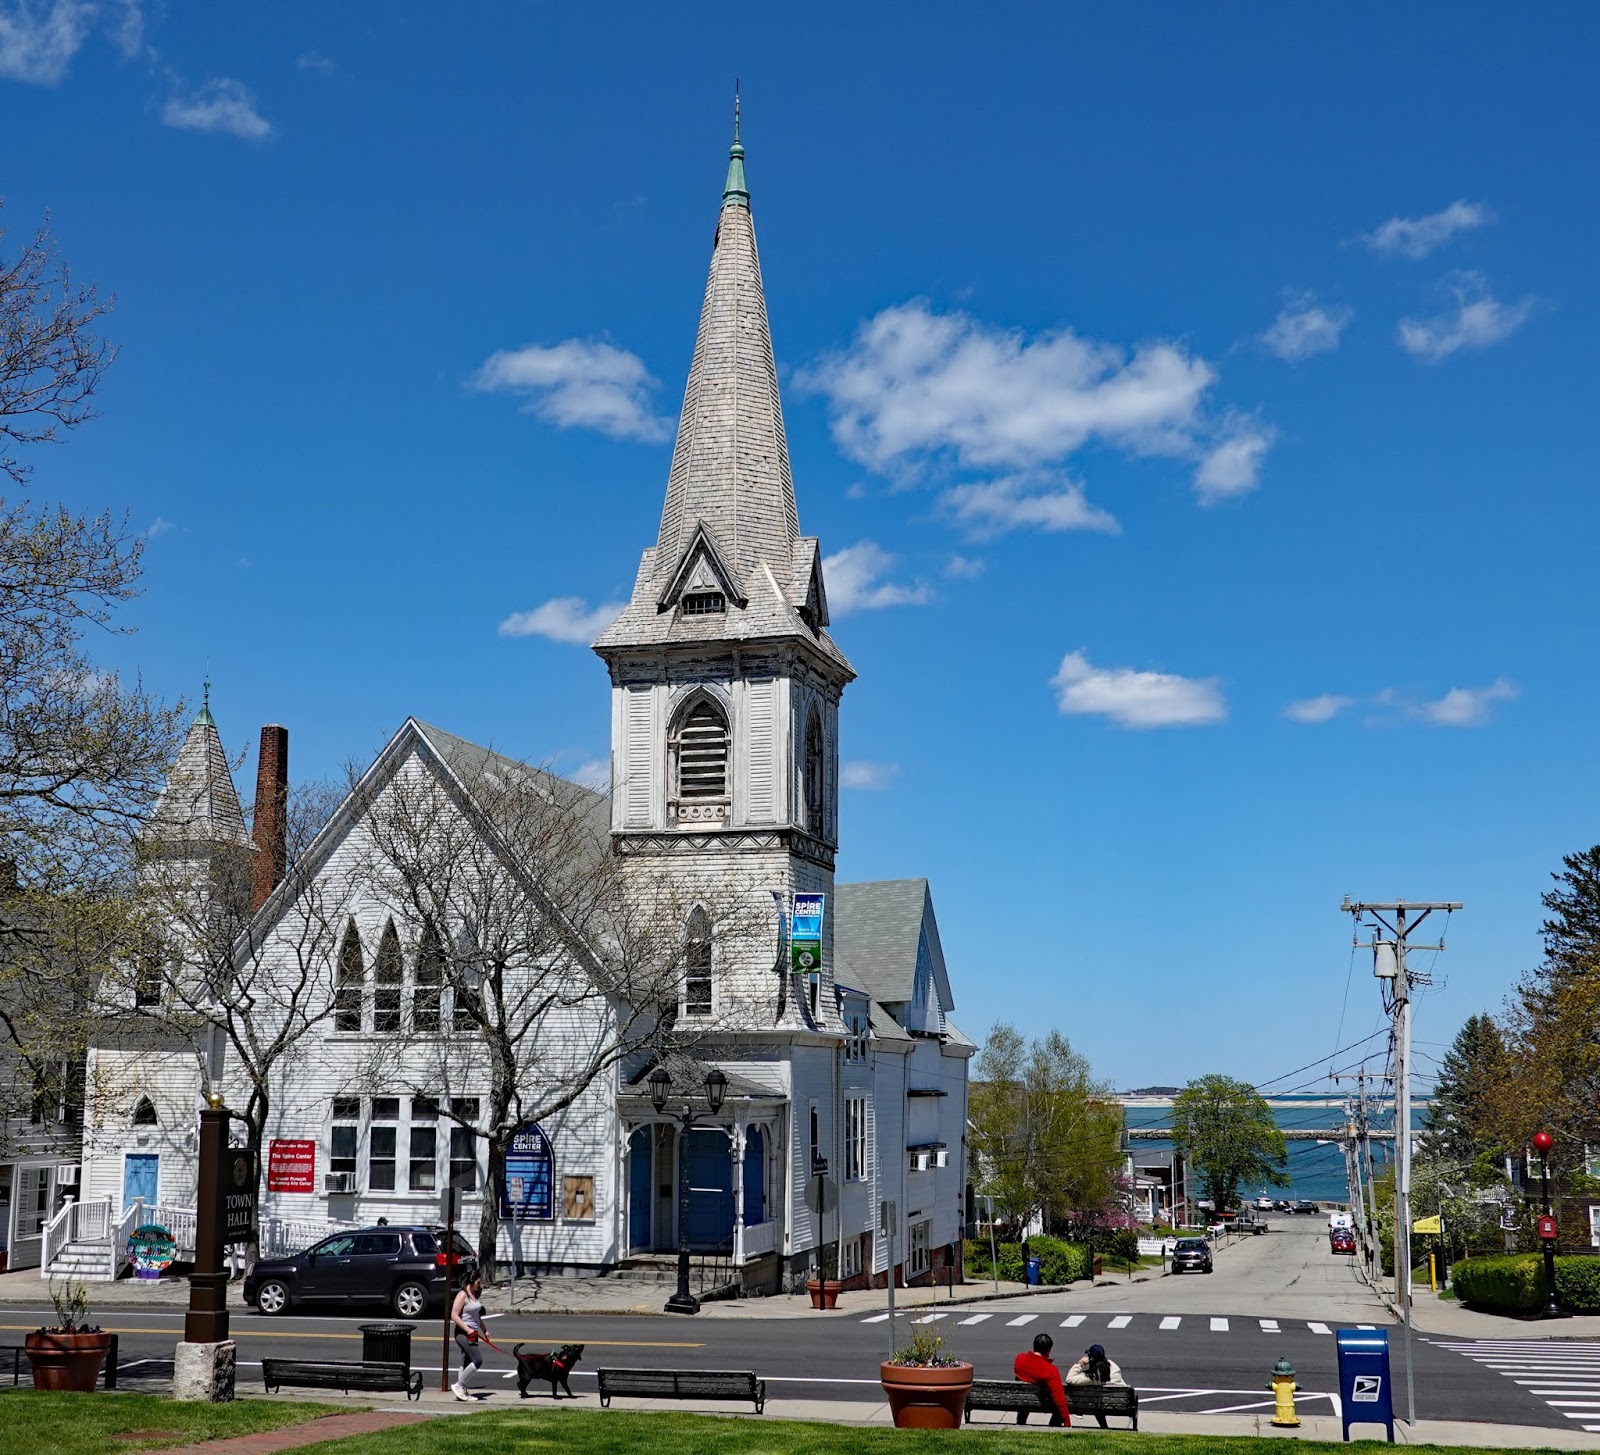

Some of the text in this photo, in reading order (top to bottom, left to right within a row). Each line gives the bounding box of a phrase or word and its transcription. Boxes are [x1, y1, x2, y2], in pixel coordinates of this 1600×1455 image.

[795, 901, 822, 910] SPIRE
[513, 1133, 542, 1143] SPIRE
[226, 1193, 252, 1209] TOWN
[227, 1211, 249, 1227] HALL
